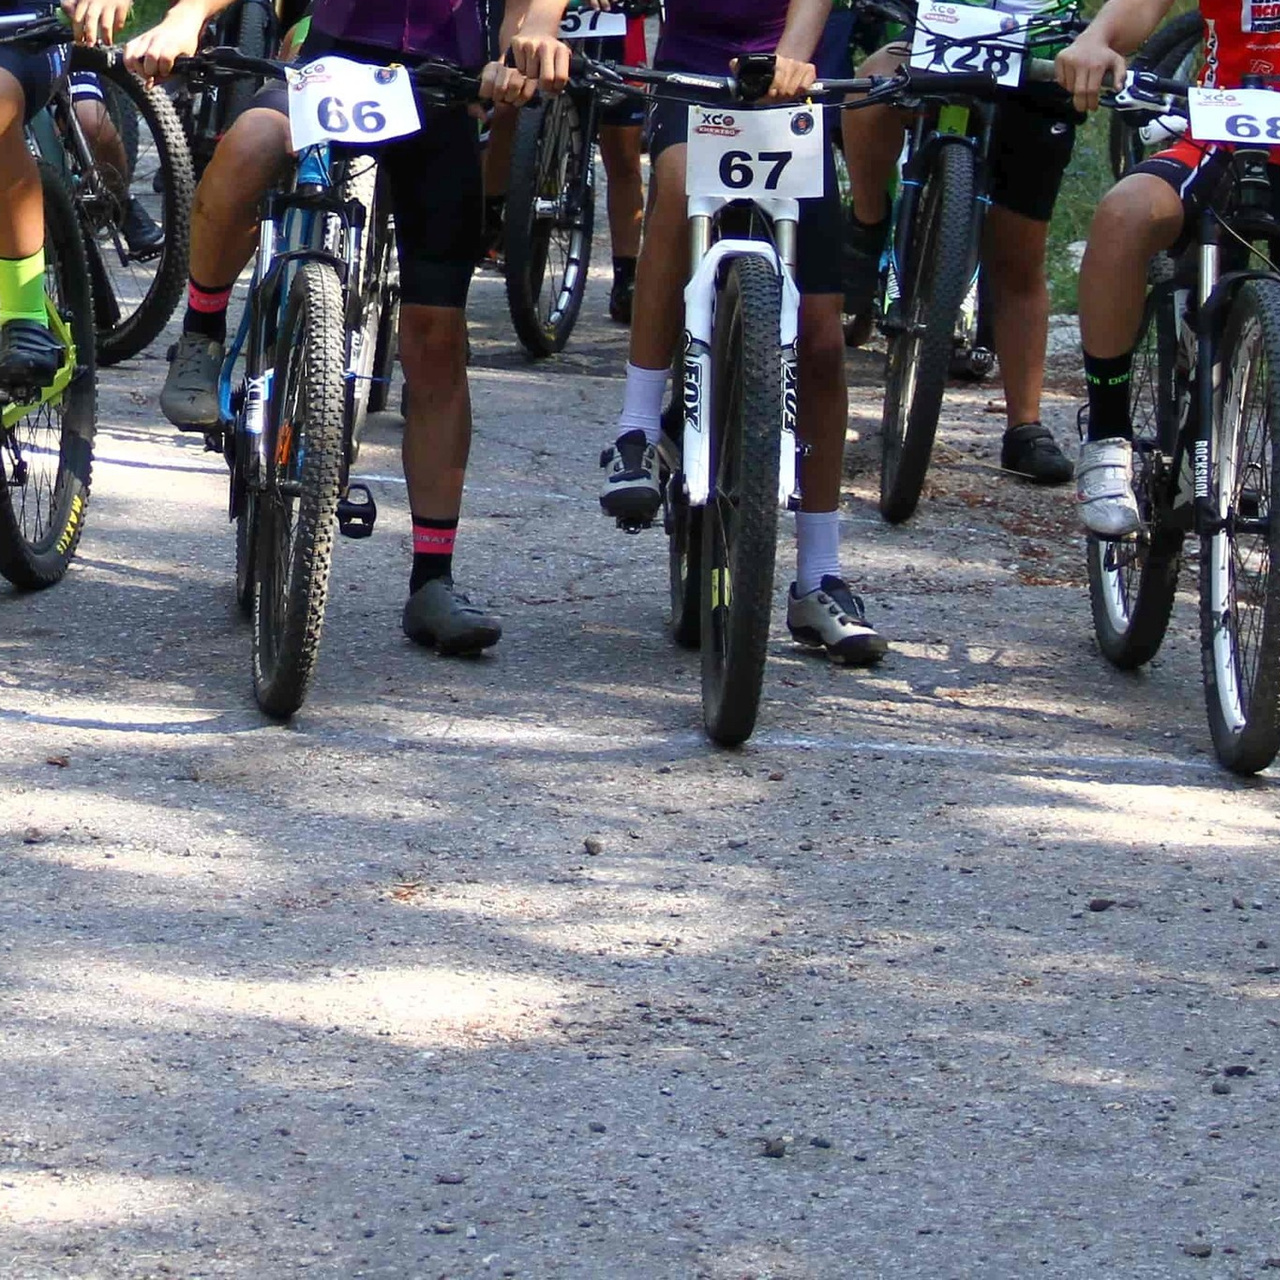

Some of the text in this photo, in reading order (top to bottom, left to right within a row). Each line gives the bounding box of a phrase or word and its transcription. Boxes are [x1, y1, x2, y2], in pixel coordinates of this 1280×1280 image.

[925, 36, 1011, 77] 128
[317, 96, 387, 133] 66
[719, 150, 793, 190] 67
[684, 362, 701, 431] FOX
[56, 494, 82, 555] MAXXIS
